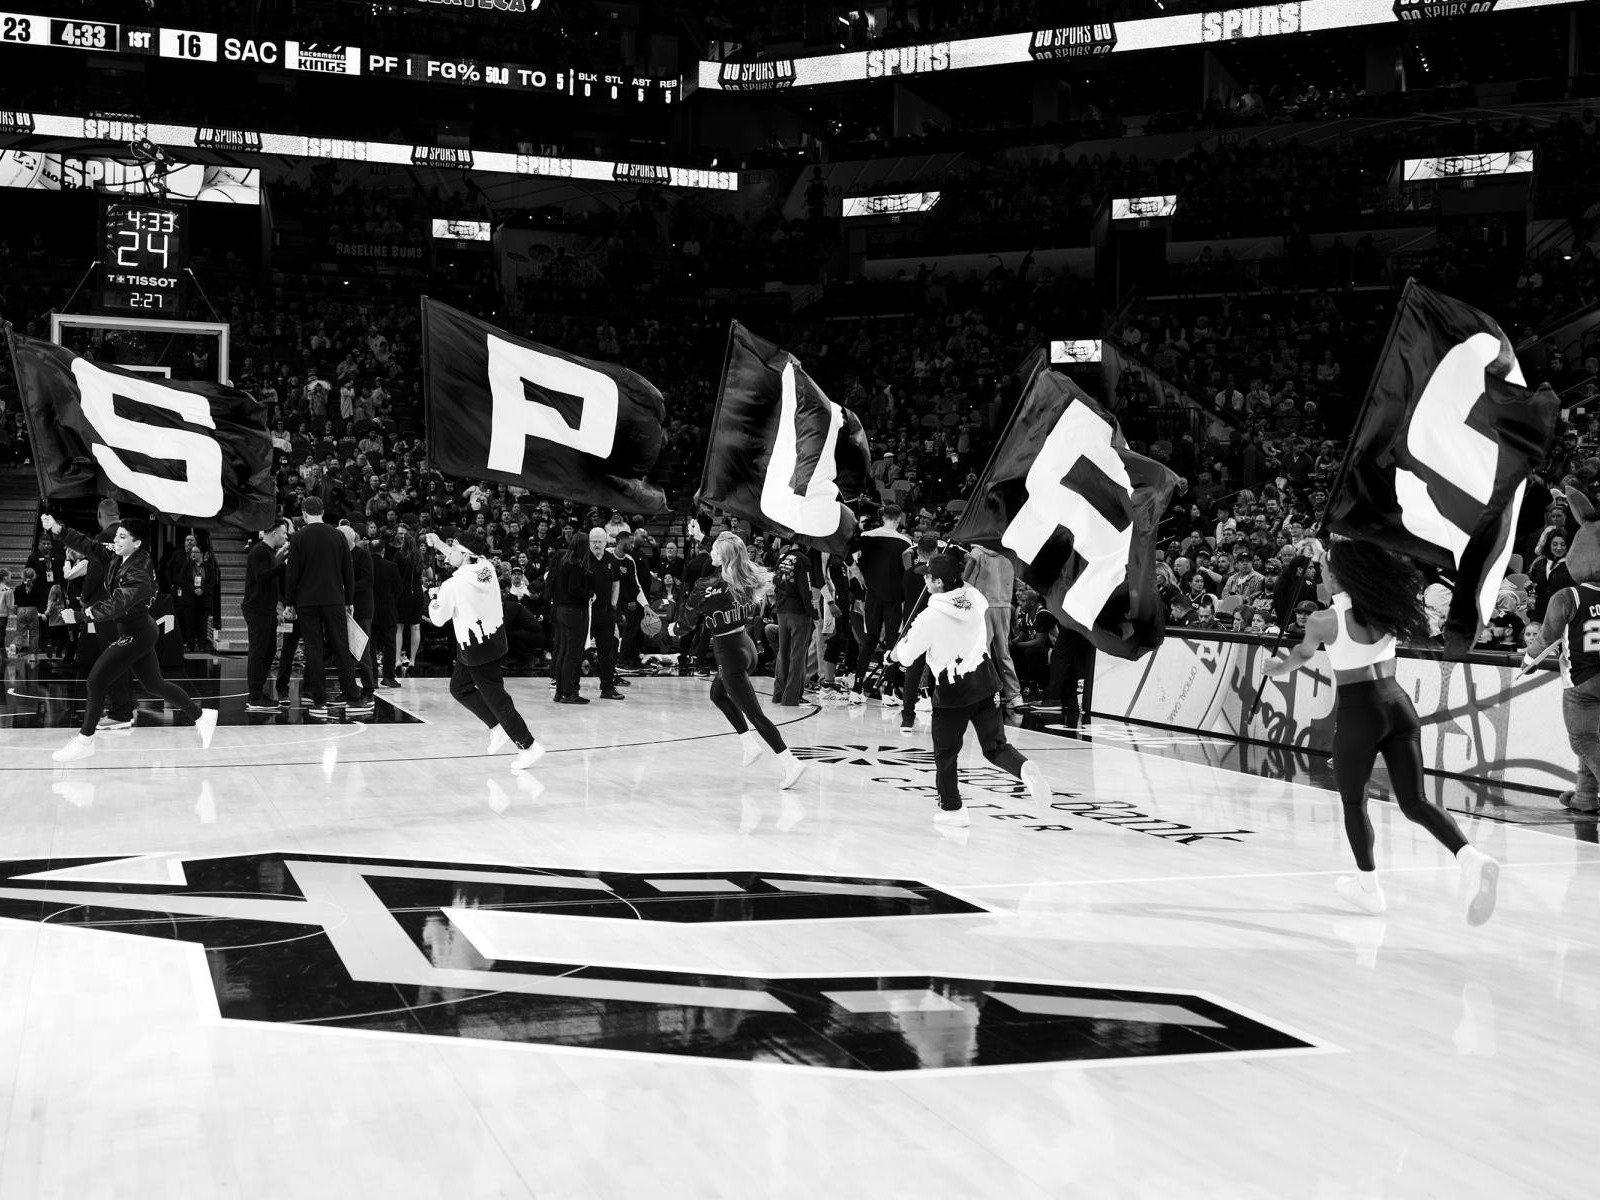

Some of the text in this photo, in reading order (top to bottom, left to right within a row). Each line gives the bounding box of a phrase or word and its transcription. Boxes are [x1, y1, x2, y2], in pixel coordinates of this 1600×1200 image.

[1203, 2, 1299, 41] SPURS
[1055, 25, 1092, 46] SPURS
[4, 17, 563, 90] 23 4:33 1ST 16 SAC PF 1 FG% 50.0 TO 5
[299, 50, 345, 60] SACRAMENTO
[868, 42, 949, 78] SPURS
[298, 58, 347, 73] KINGS
[742, 61, 775, 81] SPURS
[578, 73, 677, 89] BLK STL AST REB
[585, 84, 671, 103] 0 0 5 5
[84, 118, 146, 141] SPURS
[214, 128, 243, 145] SPURS
[308, 137, 366, 161] SPURS
[429, 146, 456, 162] SPURS
[517, 155, 572, 177] SPURS
[629, 163, 655, 178] SPURS
[678, 168, 730, 190] SPURS
[128, 210, 173, 233] 4:33
[118, 230, 168, 269] 24
[336, 241, 388, 257] BASELINE
[126, 275, 177, 288] TISSOT
[130, 292, 162, 308] 2:27
[487, 334, 618, 474] P
[71, 358, 223, 517] S
[760, 361, 844, 537] U
[1001, 398, 1134, 631] R
[871, 777, 1074, 832] CETER
